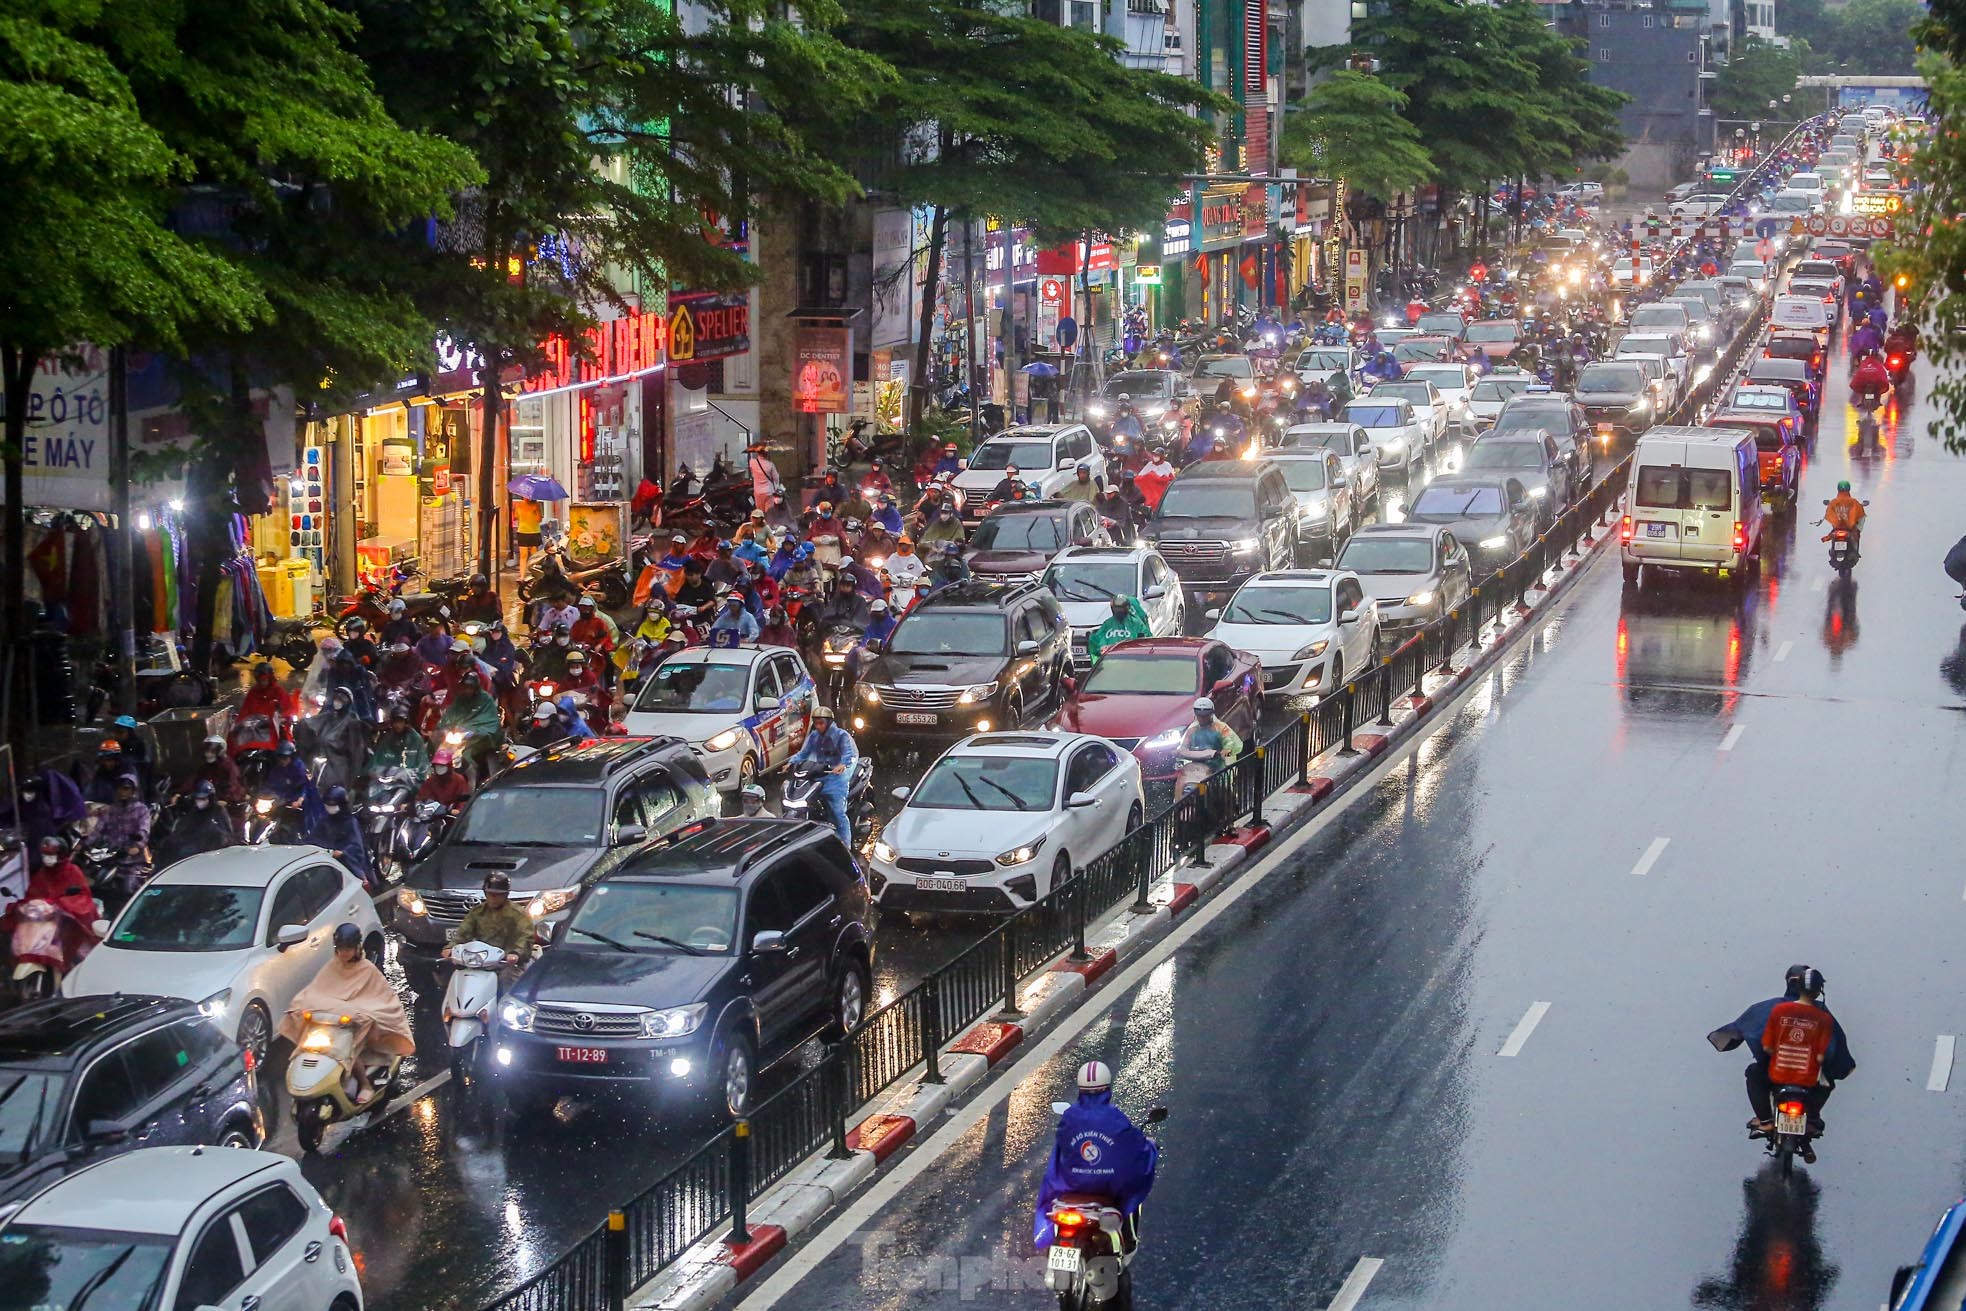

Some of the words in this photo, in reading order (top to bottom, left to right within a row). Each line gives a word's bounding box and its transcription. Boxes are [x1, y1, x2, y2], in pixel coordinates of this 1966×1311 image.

[696, 306, 750, 341] SPELIER
[74, 389, 105, 425] TÔ
[45, 432, 94, 469] MÁY
[917, 879, 965, 891] 30G-040.66
[558, 1047, 606, 1062] TT-12-89
[649, 1048, 677, 1058] TM-10
